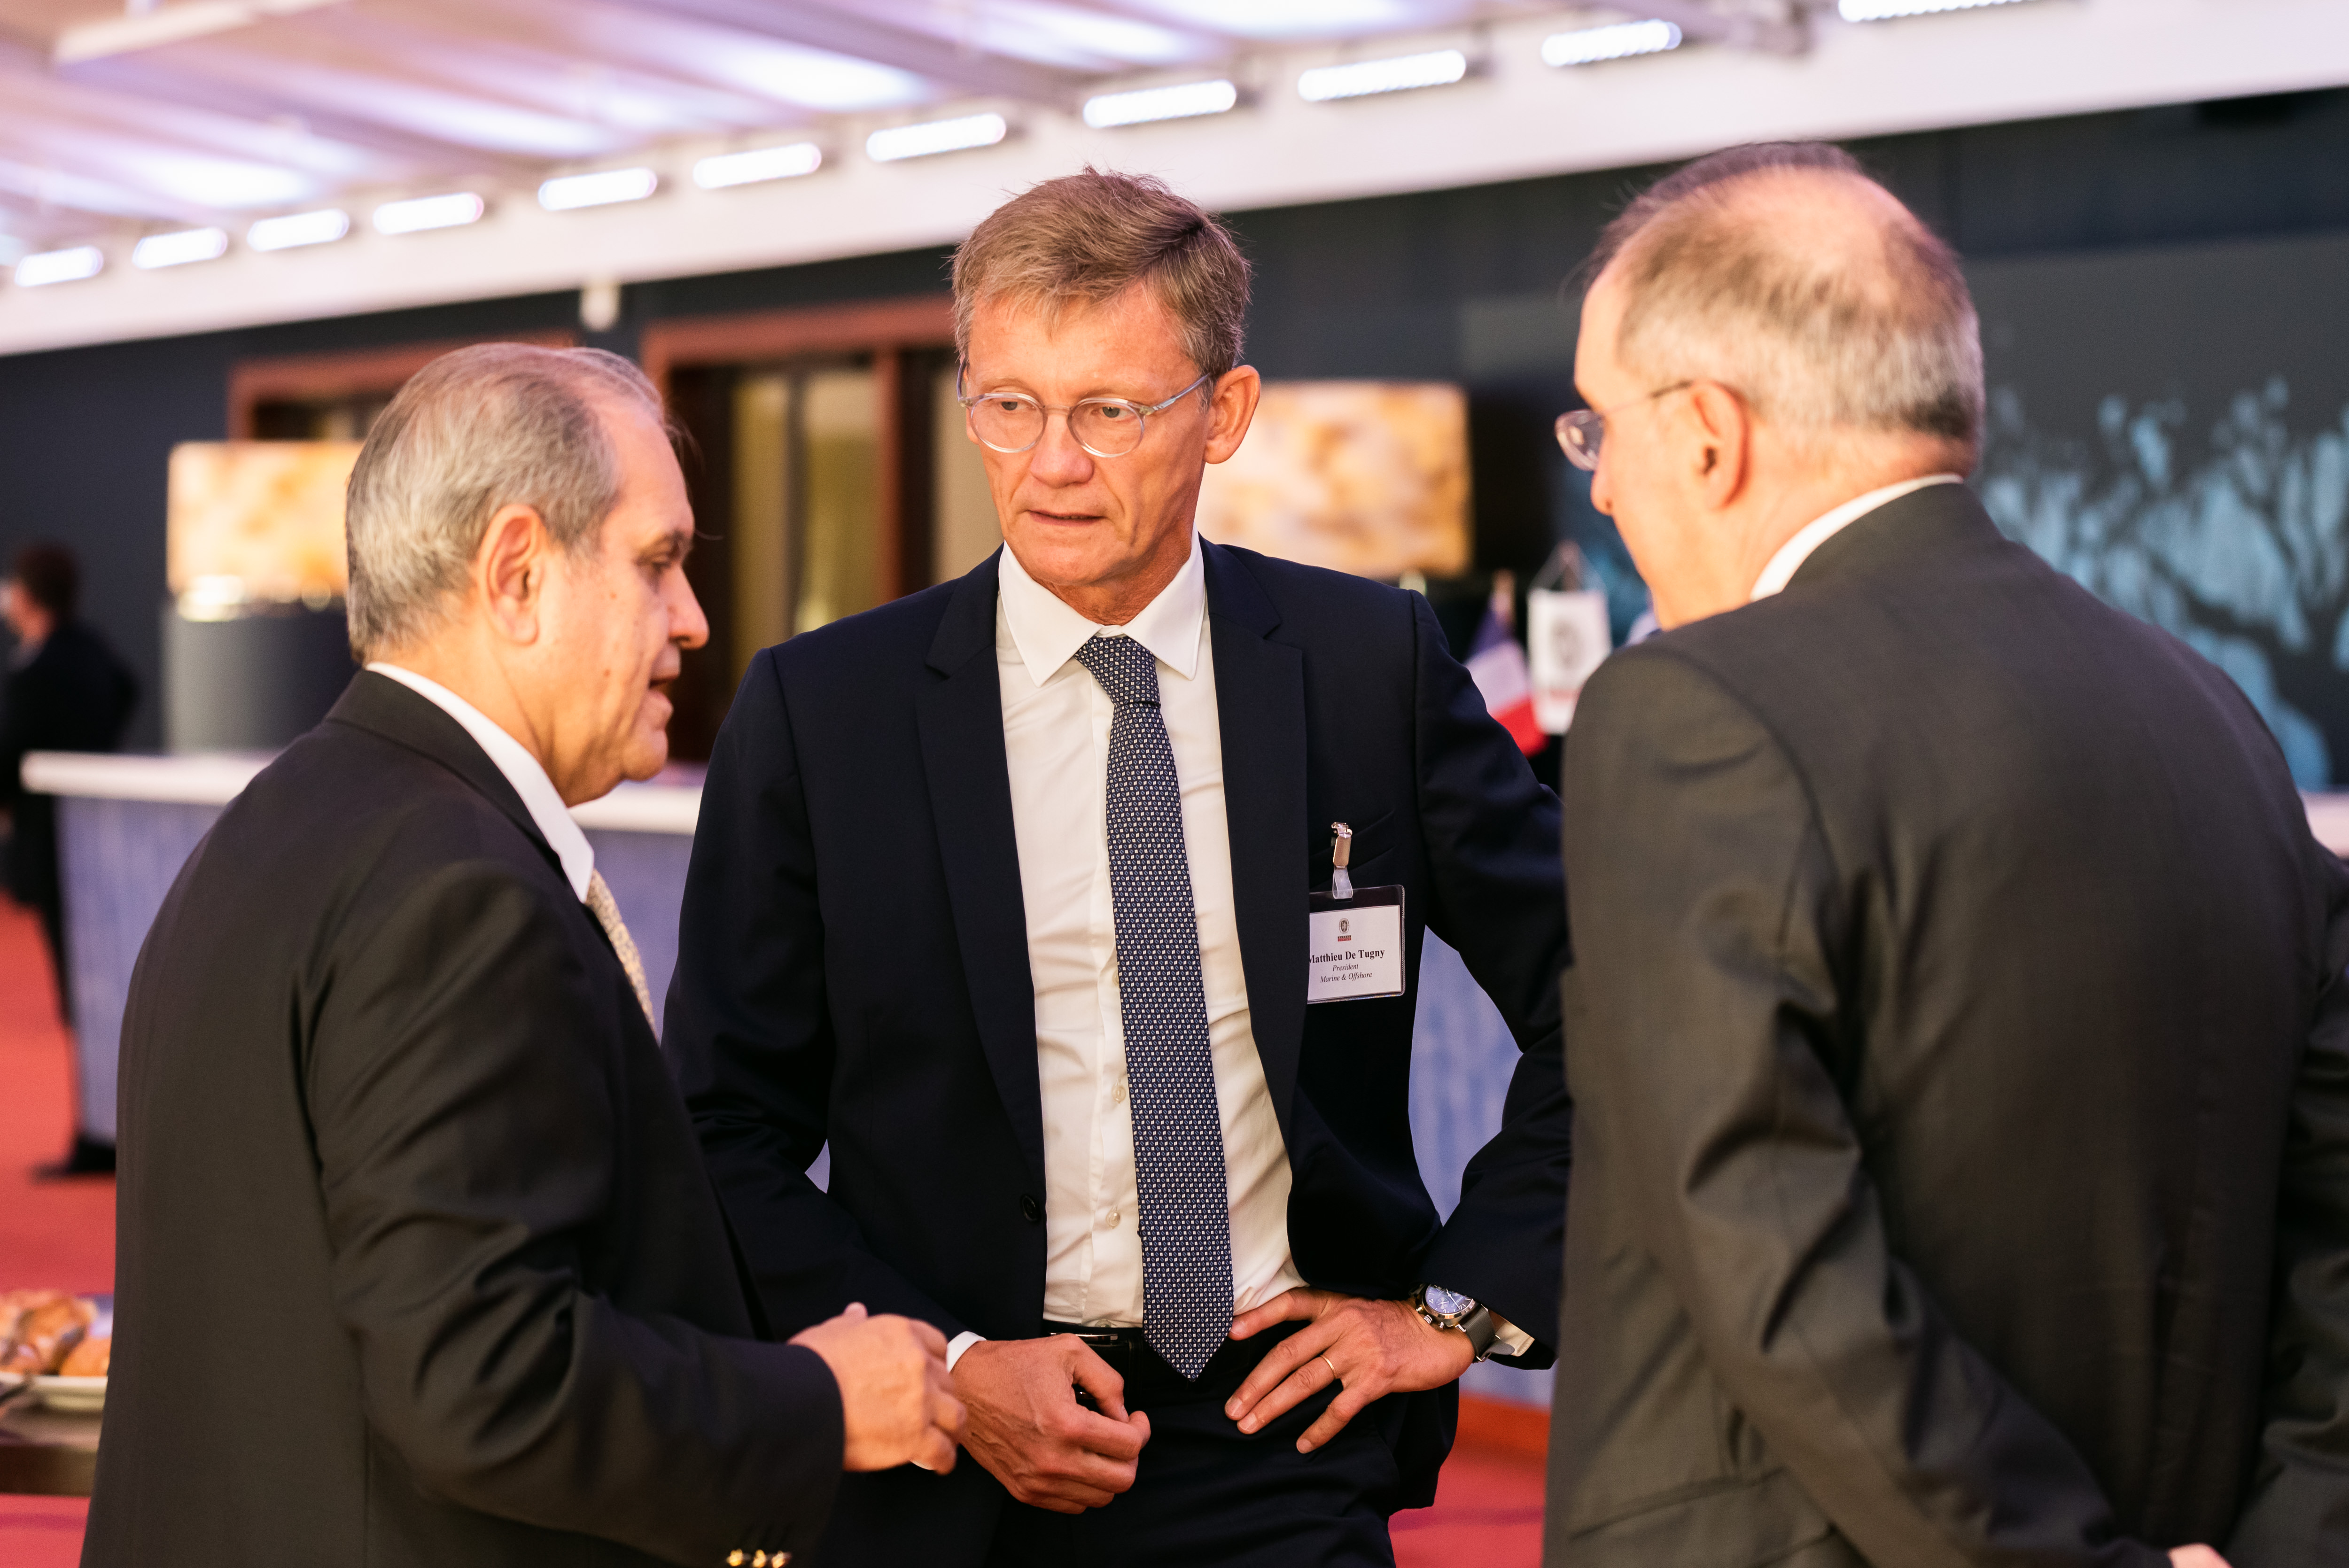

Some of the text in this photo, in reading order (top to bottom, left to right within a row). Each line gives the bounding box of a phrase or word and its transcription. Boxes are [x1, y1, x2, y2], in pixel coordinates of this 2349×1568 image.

[1345, 951, 1356, 960] De
[1358, 949, 1385, 959] Tugny
[1332, 963, 1359, 971] President
[1348, 972, 1372, 981] Offshore
